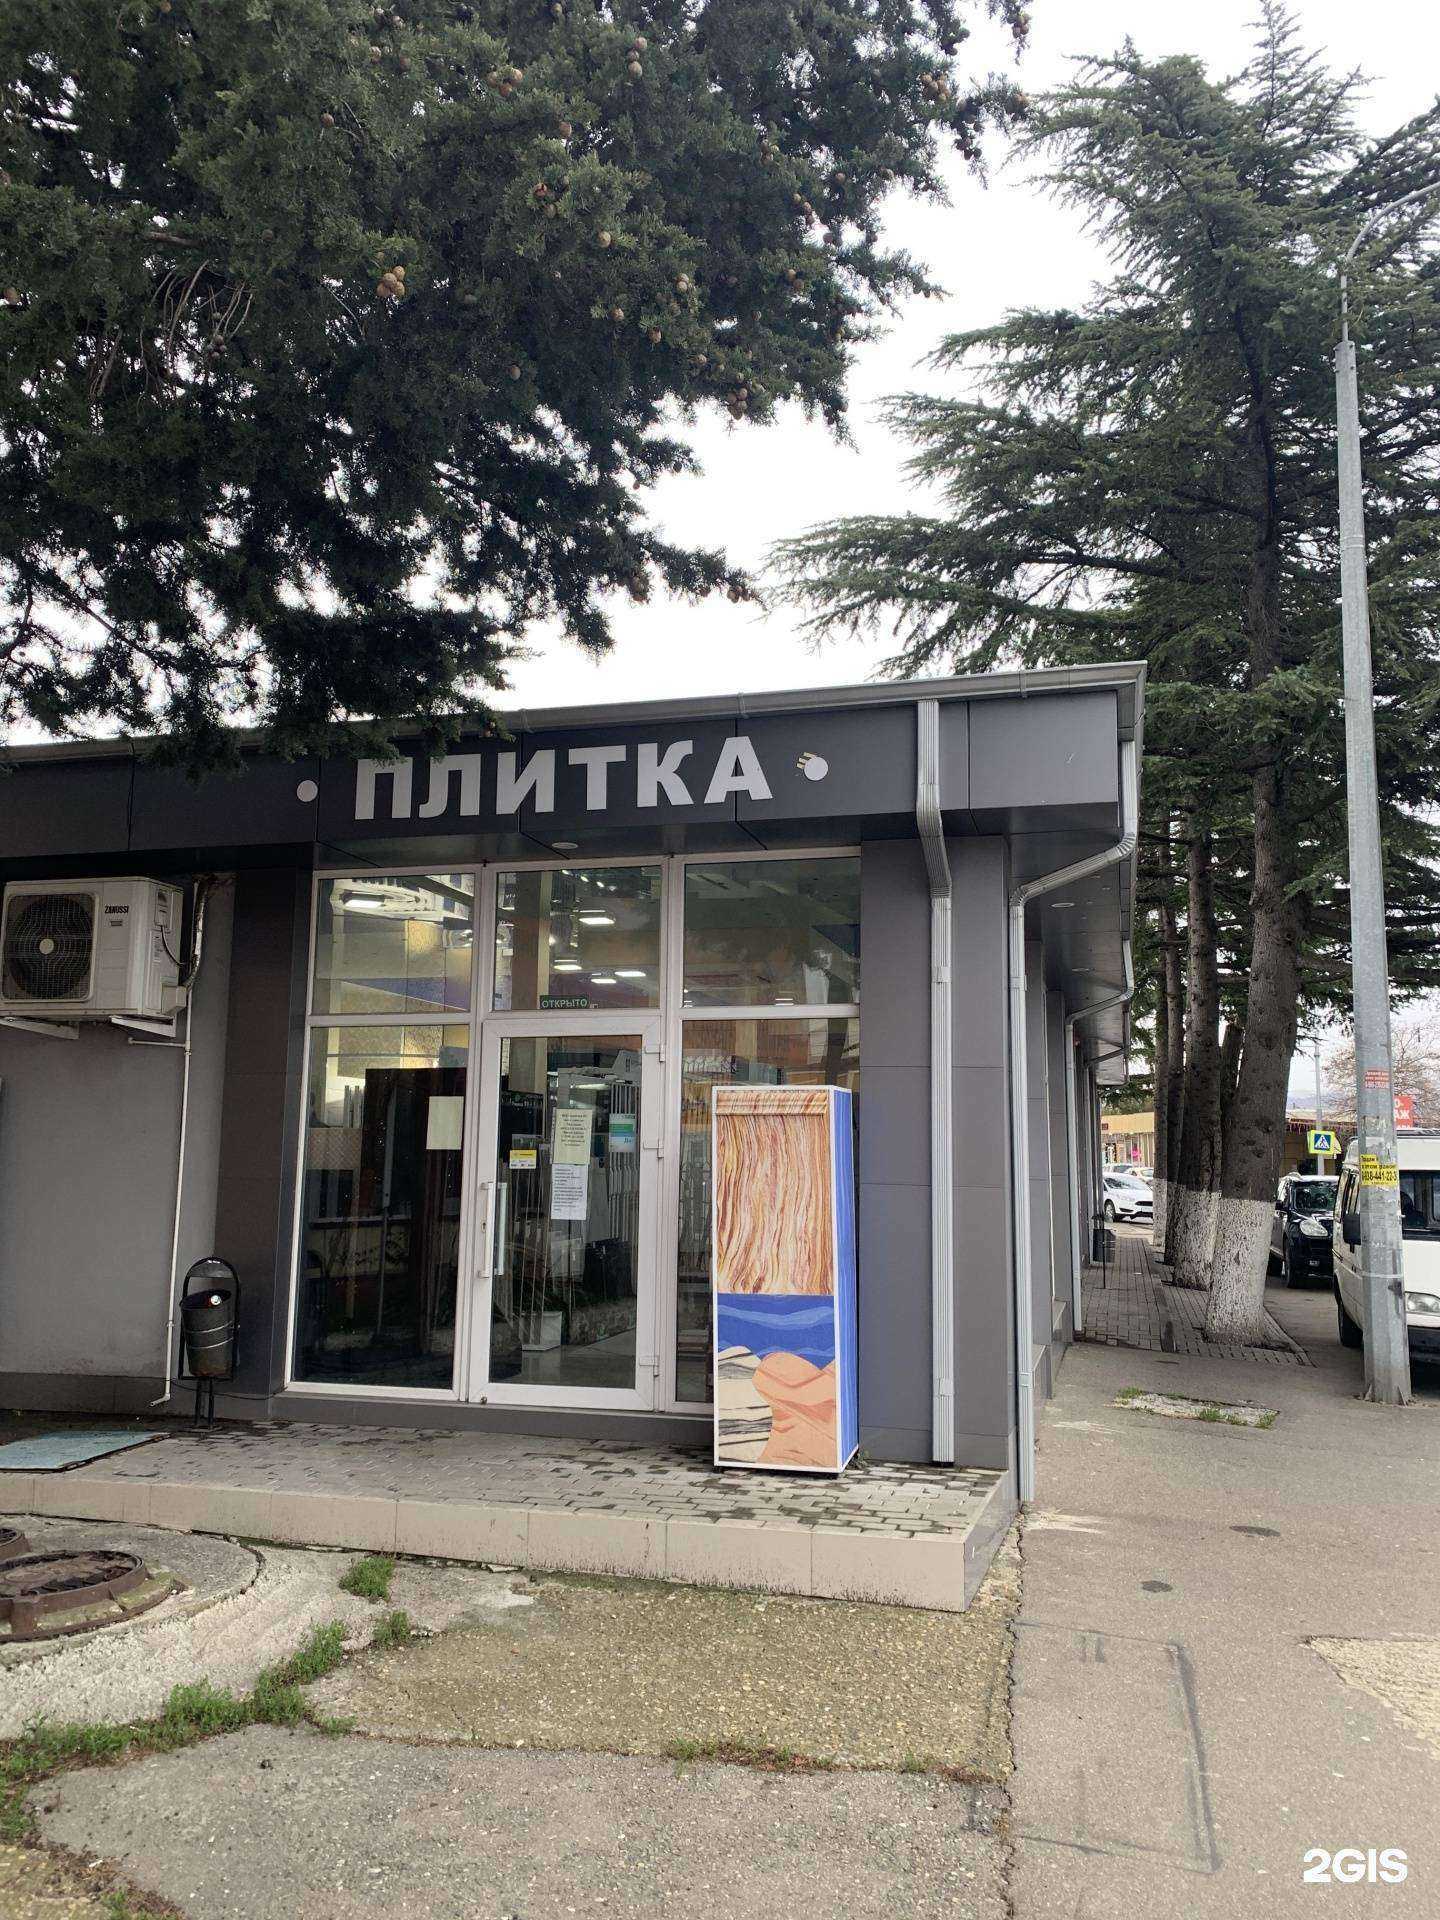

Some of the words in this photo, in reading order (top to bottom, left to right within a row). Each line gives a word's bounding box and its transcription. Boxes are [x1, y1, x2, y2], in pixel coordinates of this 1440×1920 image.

[354, 735, 773, 821] ПЛИТКА
[104, 905, 129, 914] ZANUSSI
[541, 998, 588, 1008] ОТКРЫТО
